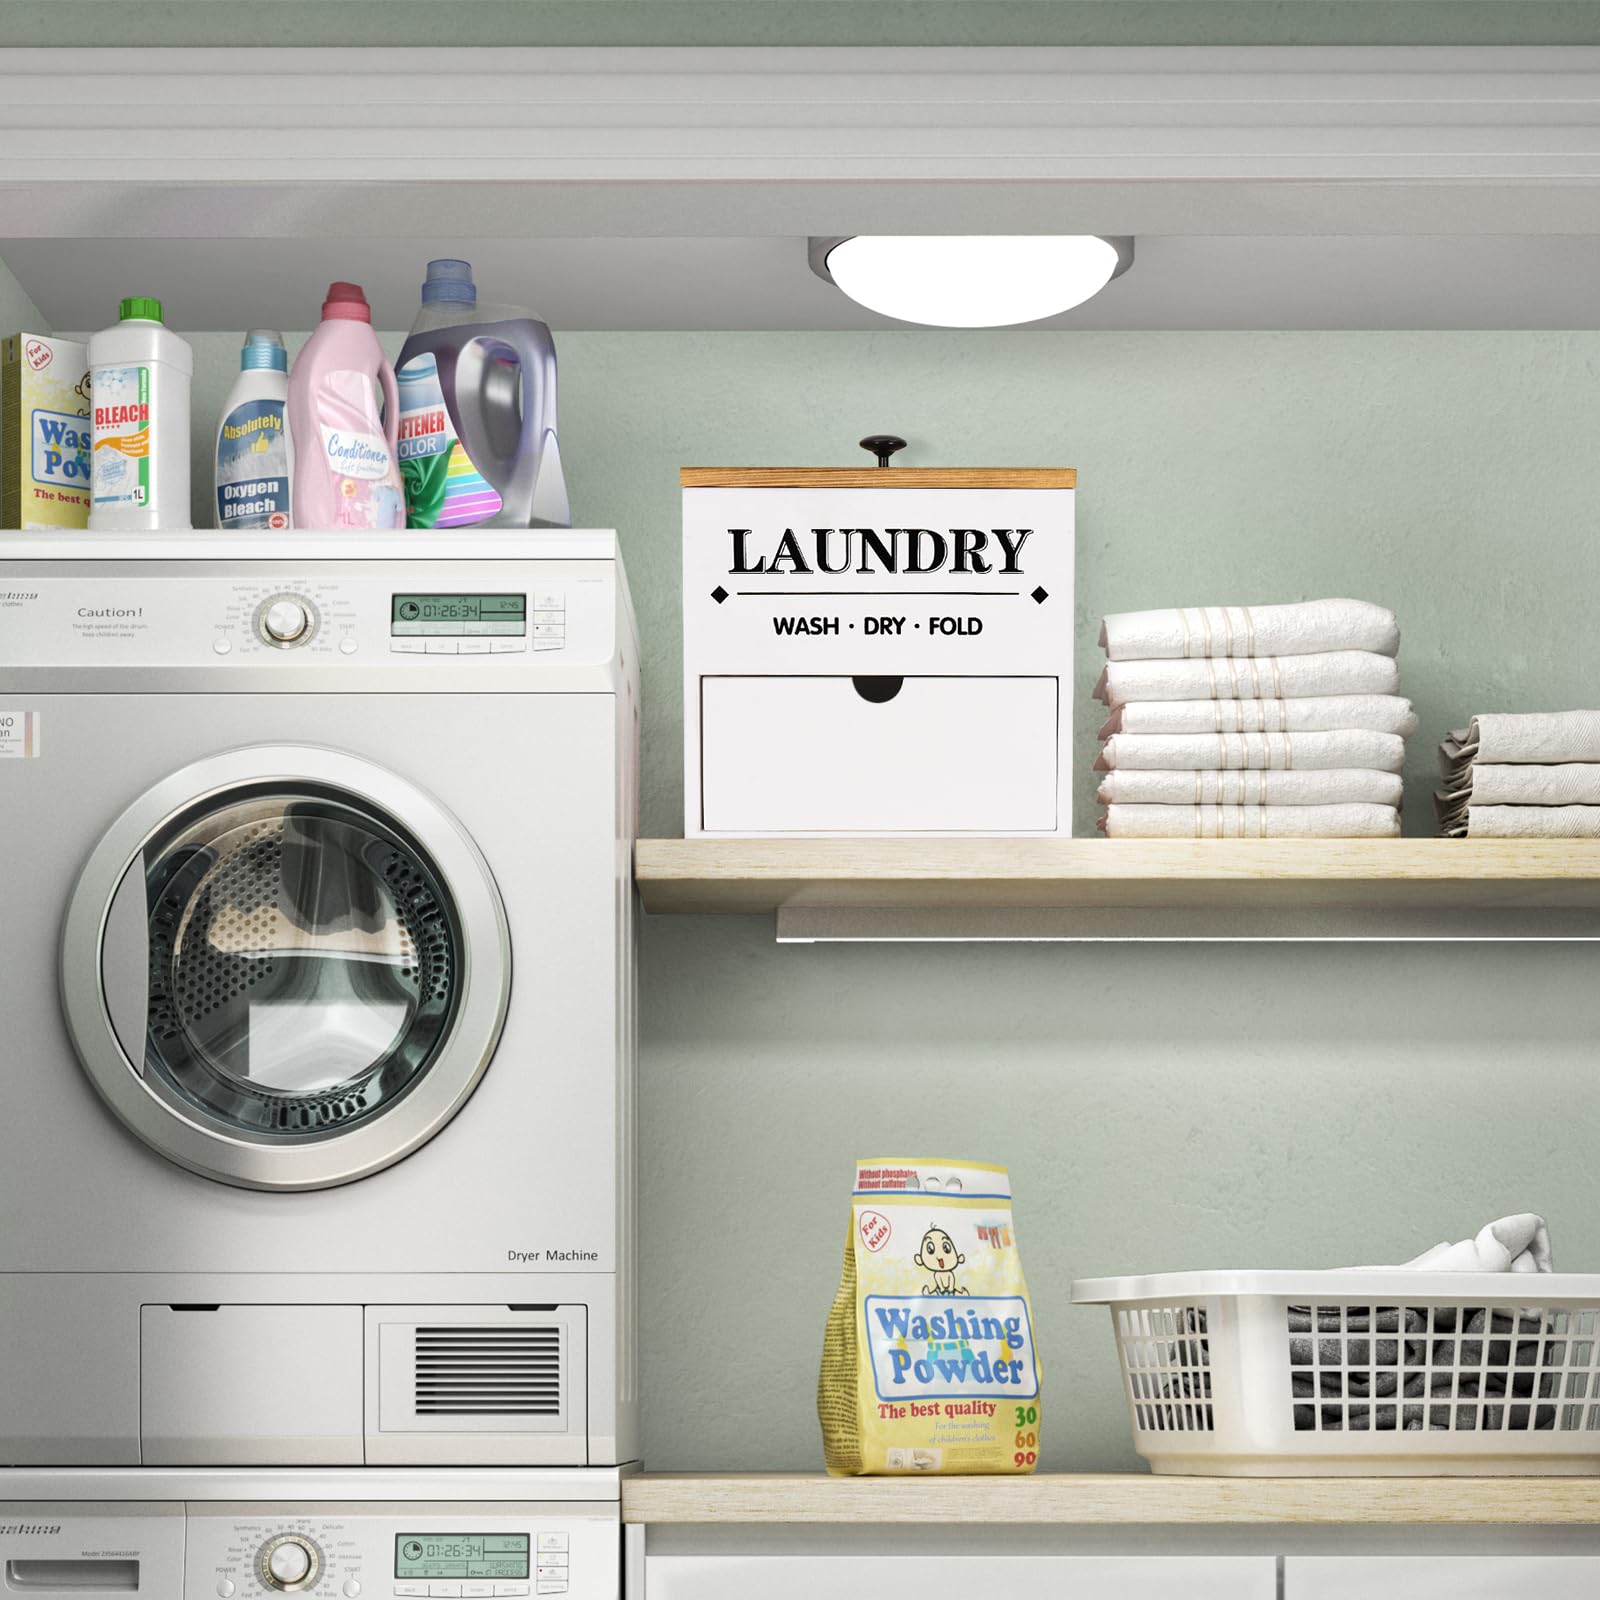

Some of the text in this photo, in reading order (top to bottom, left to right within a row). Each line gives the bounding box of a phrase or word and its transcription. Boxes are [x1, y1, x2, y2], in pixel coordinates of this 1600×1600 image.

[29, 345, 41, 357] For
[33, 352, 50, 367] Kids
[95, 404, 149, 425] BLEACH
[224, 415, 281, 439] Absolutely
[328, 433, 388, 464] Conditioner
[34, 488, 54, 500] The
[58, 492, 80, 504] best
[133, 489, 143, 500] 1L
[225, 481, 279, 500] Oxygen
[225, 498, 275, 519] Bleach
[727, 528, 1034, 575] LAUNDRY
[423, 605, 478, 617] 01:26:34
[773, 617, 983, 635] WASH DRY FOLD
[862, 1216, 878, 1236] For
[868, 1224, 888, 1249] Kids
[508, 1250, 598, 1263] Dryer Machine
[875, 1308, 1025, 1349] Washing
[888, 1349, 1024, 1384] Powder
[877, 1400, 998, 1419] The best quality
[1015, 1406, 1037, 1428] 30
[1015, 1430, 1036, 1449] 60
[1014, 1451, 1037, 1468] 90
[427, 1544, 481, 1557] 01:26:34
